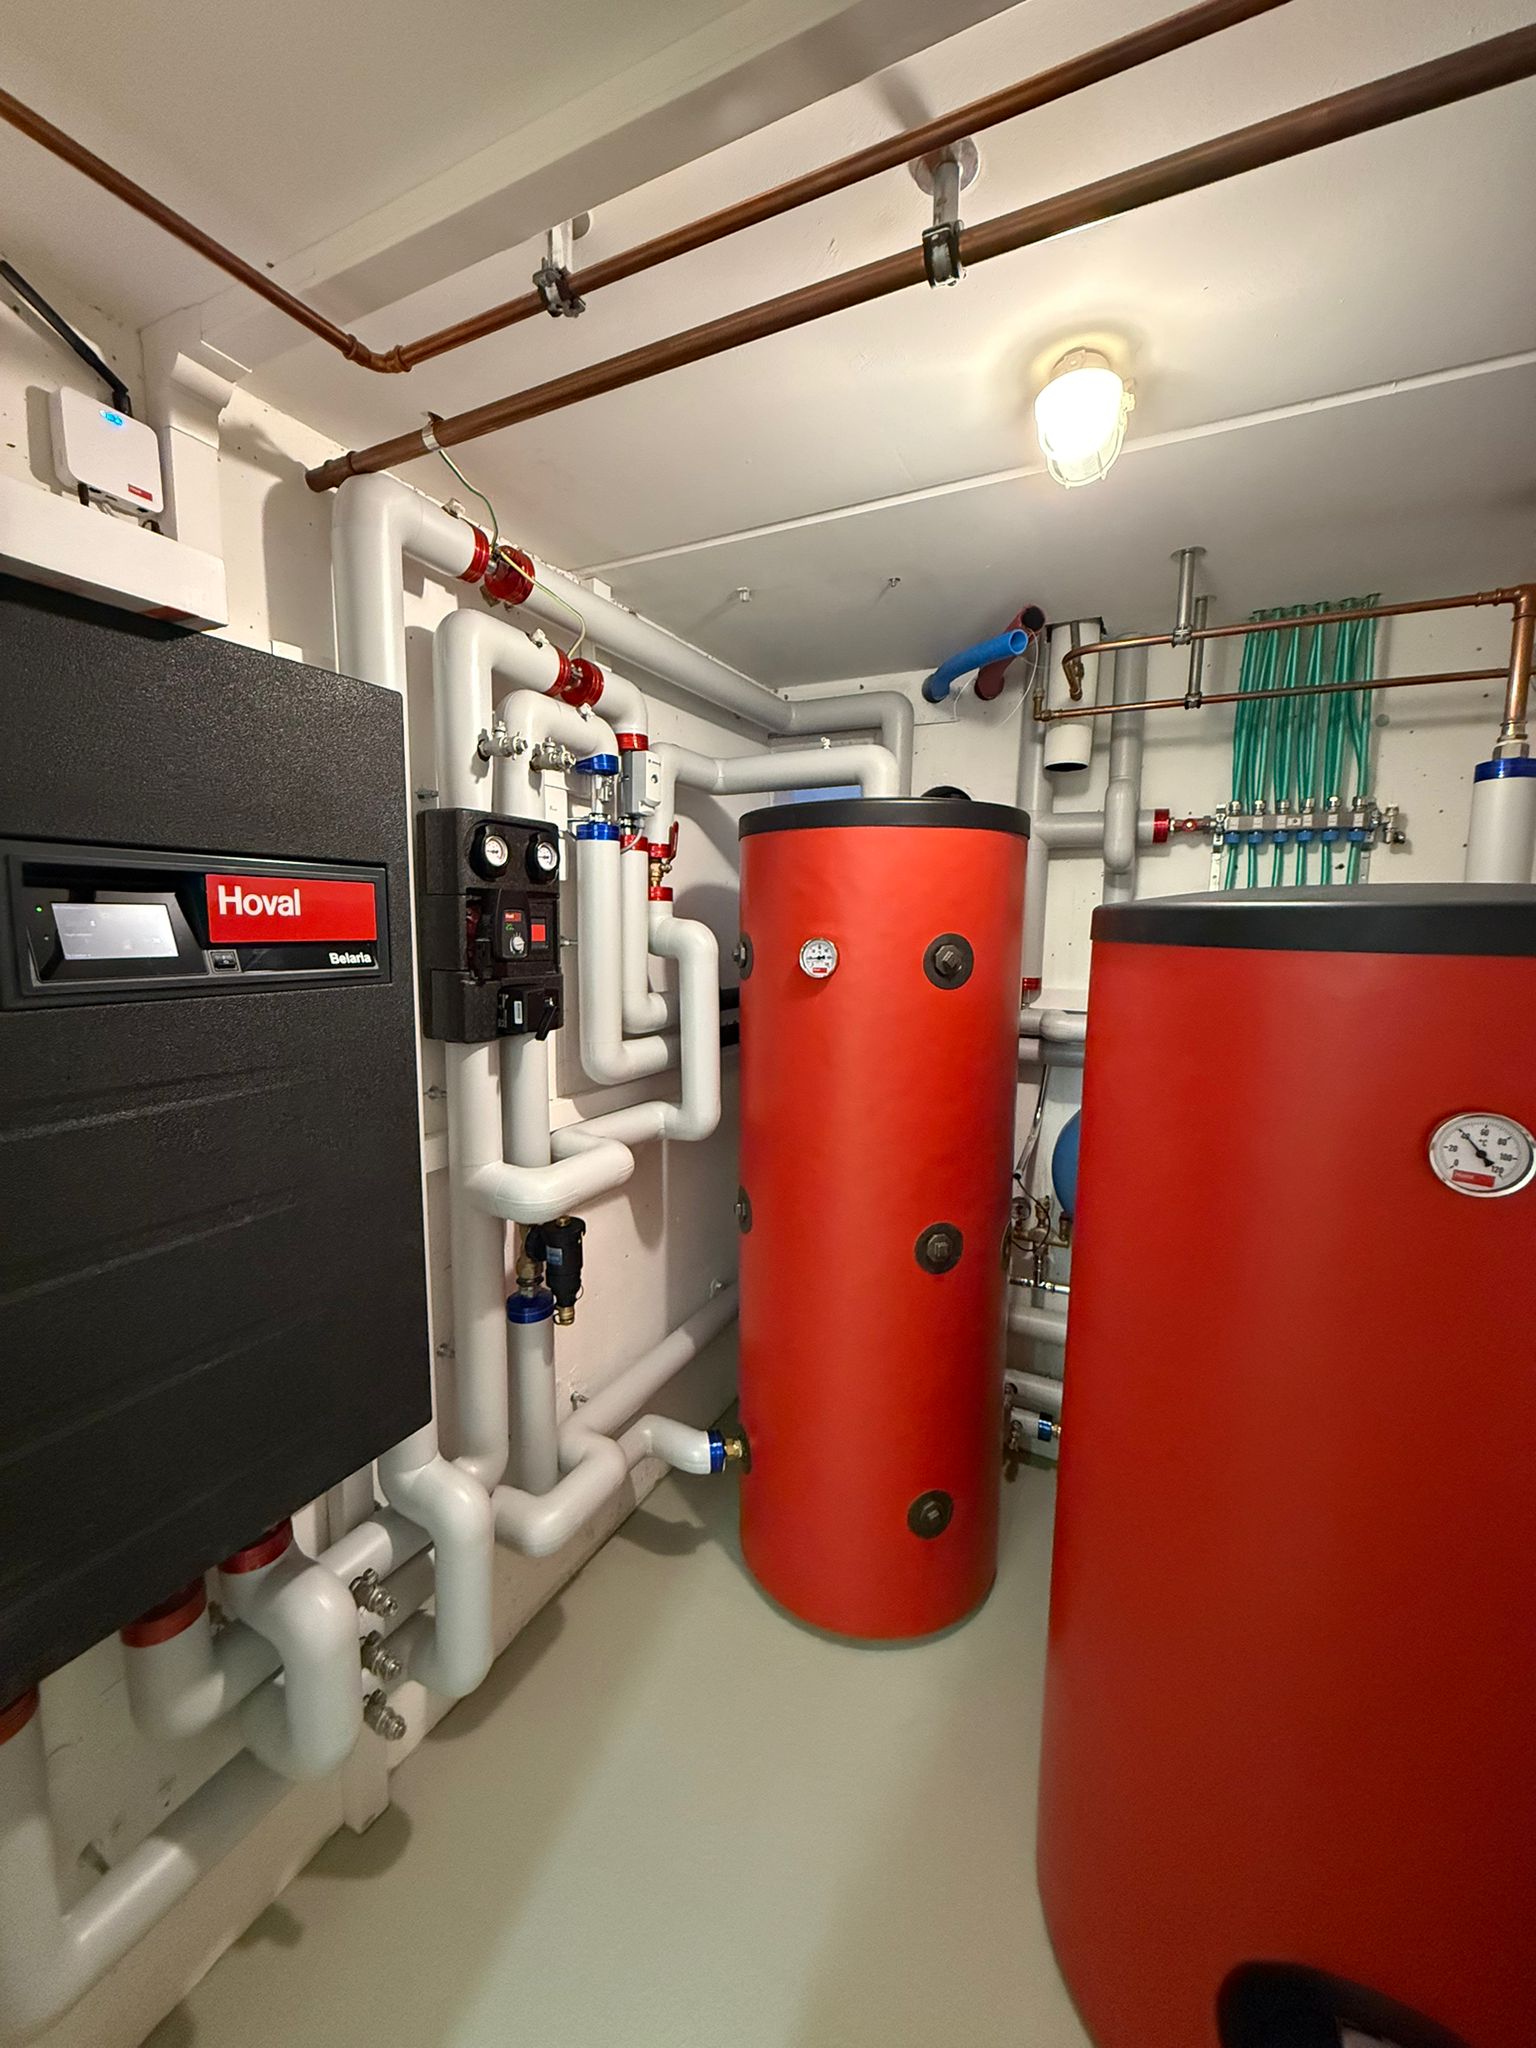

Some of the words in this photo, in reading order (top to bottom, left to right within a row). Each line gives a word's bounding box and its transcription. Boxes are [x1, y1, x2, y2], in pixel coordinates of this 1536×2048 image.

[218, 884, 301, 916] Hoval
[328, 951, 372, 965] Belaria
[1448, 1144, 1458, 1152] 20
[1492, 1166, 1504, 1174] 120
